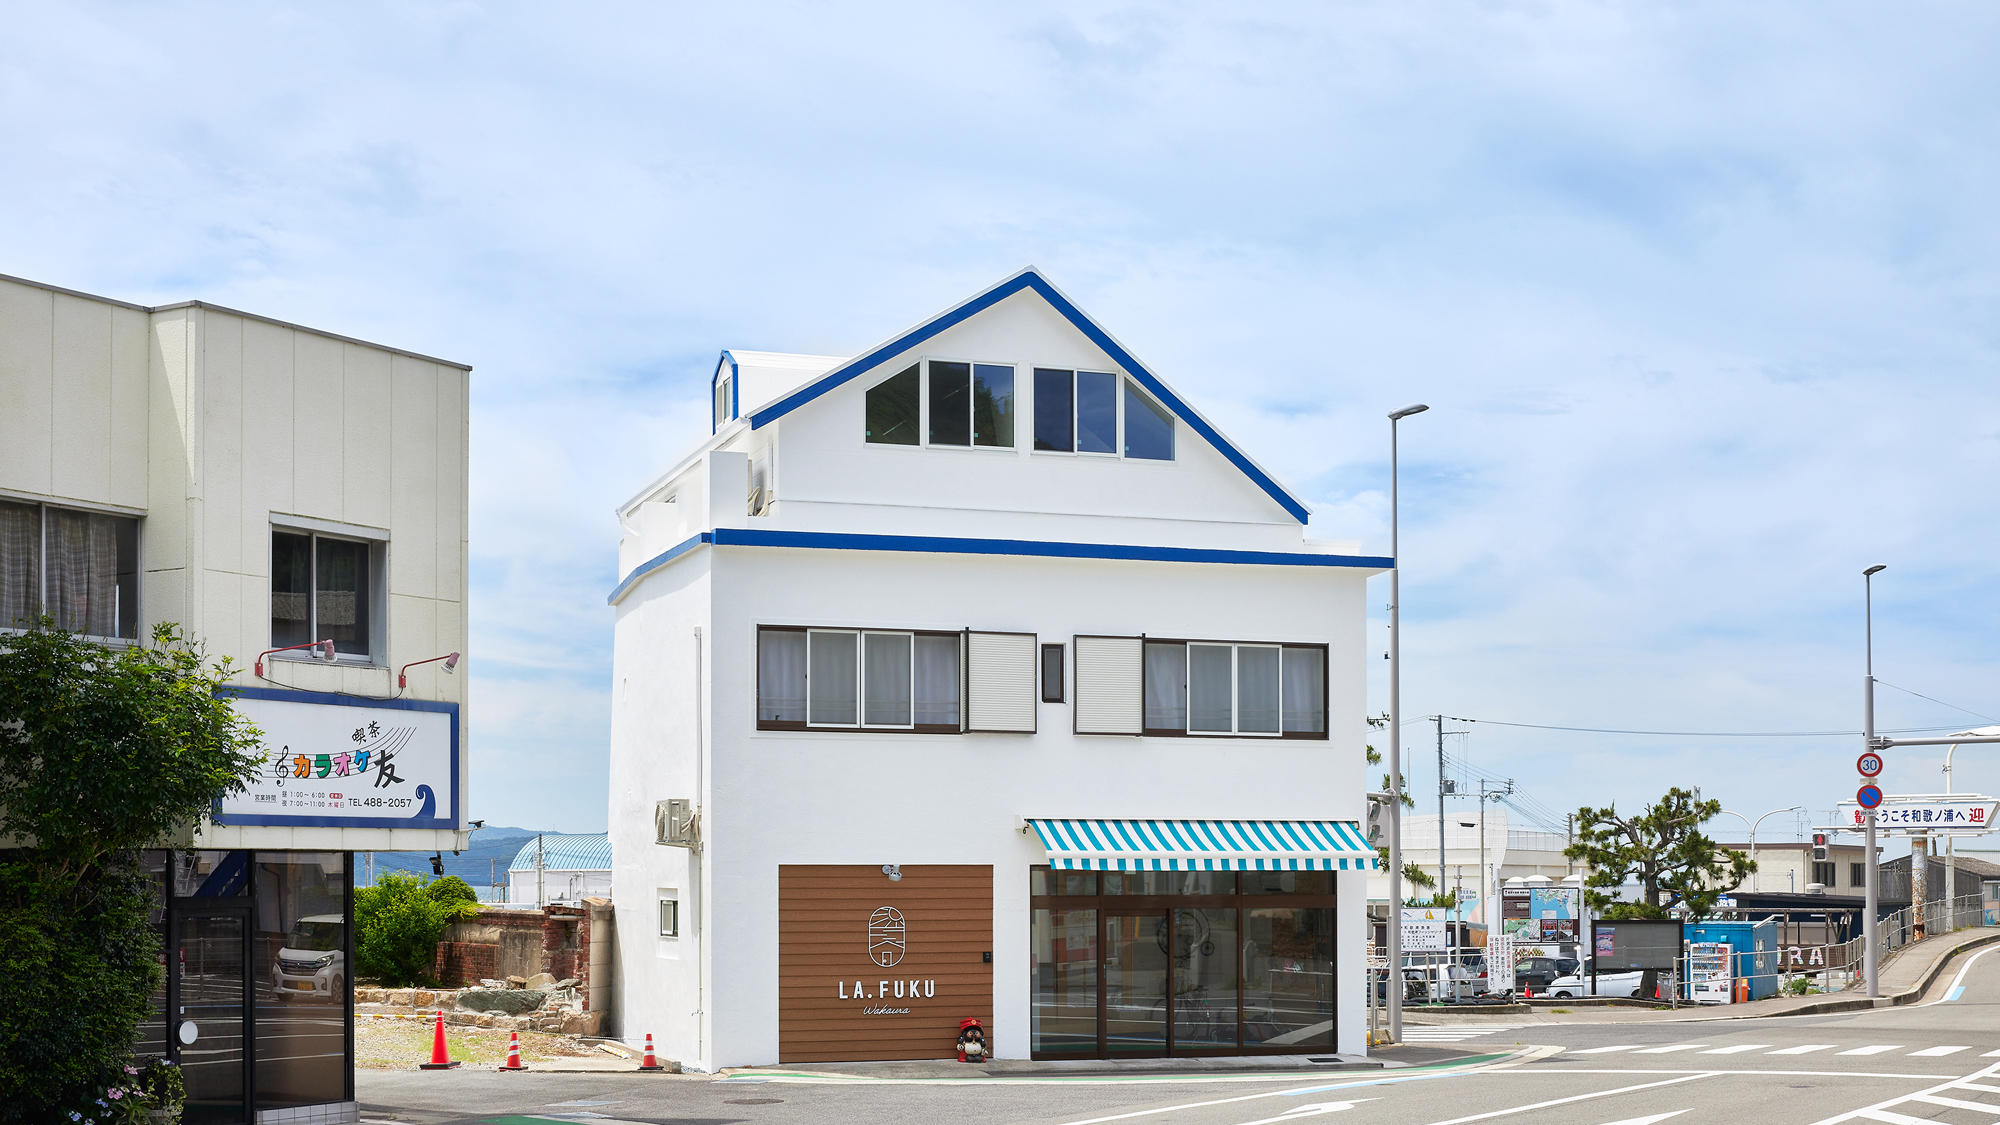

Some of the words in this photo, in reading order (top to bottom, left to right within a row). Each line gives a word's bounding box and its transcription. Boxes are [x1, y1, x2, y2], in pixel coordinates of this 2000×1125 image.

[352, 720, 381, 745] 喫茶
[293, 750, 371, 778] カラオケ
[374, 750, 405, 788] 友
[1862, 760, 1878, 771] 30
[254, 794, 277, 802] 営業時間
[347, 798, 363, 807] TEL
[363, 797, 412, 808] 488-2057
[327, 801, 345, 809] 木曜日
[1968, 807, 1985, 823] 迎
[1777, 946, 1824, 965] RA
